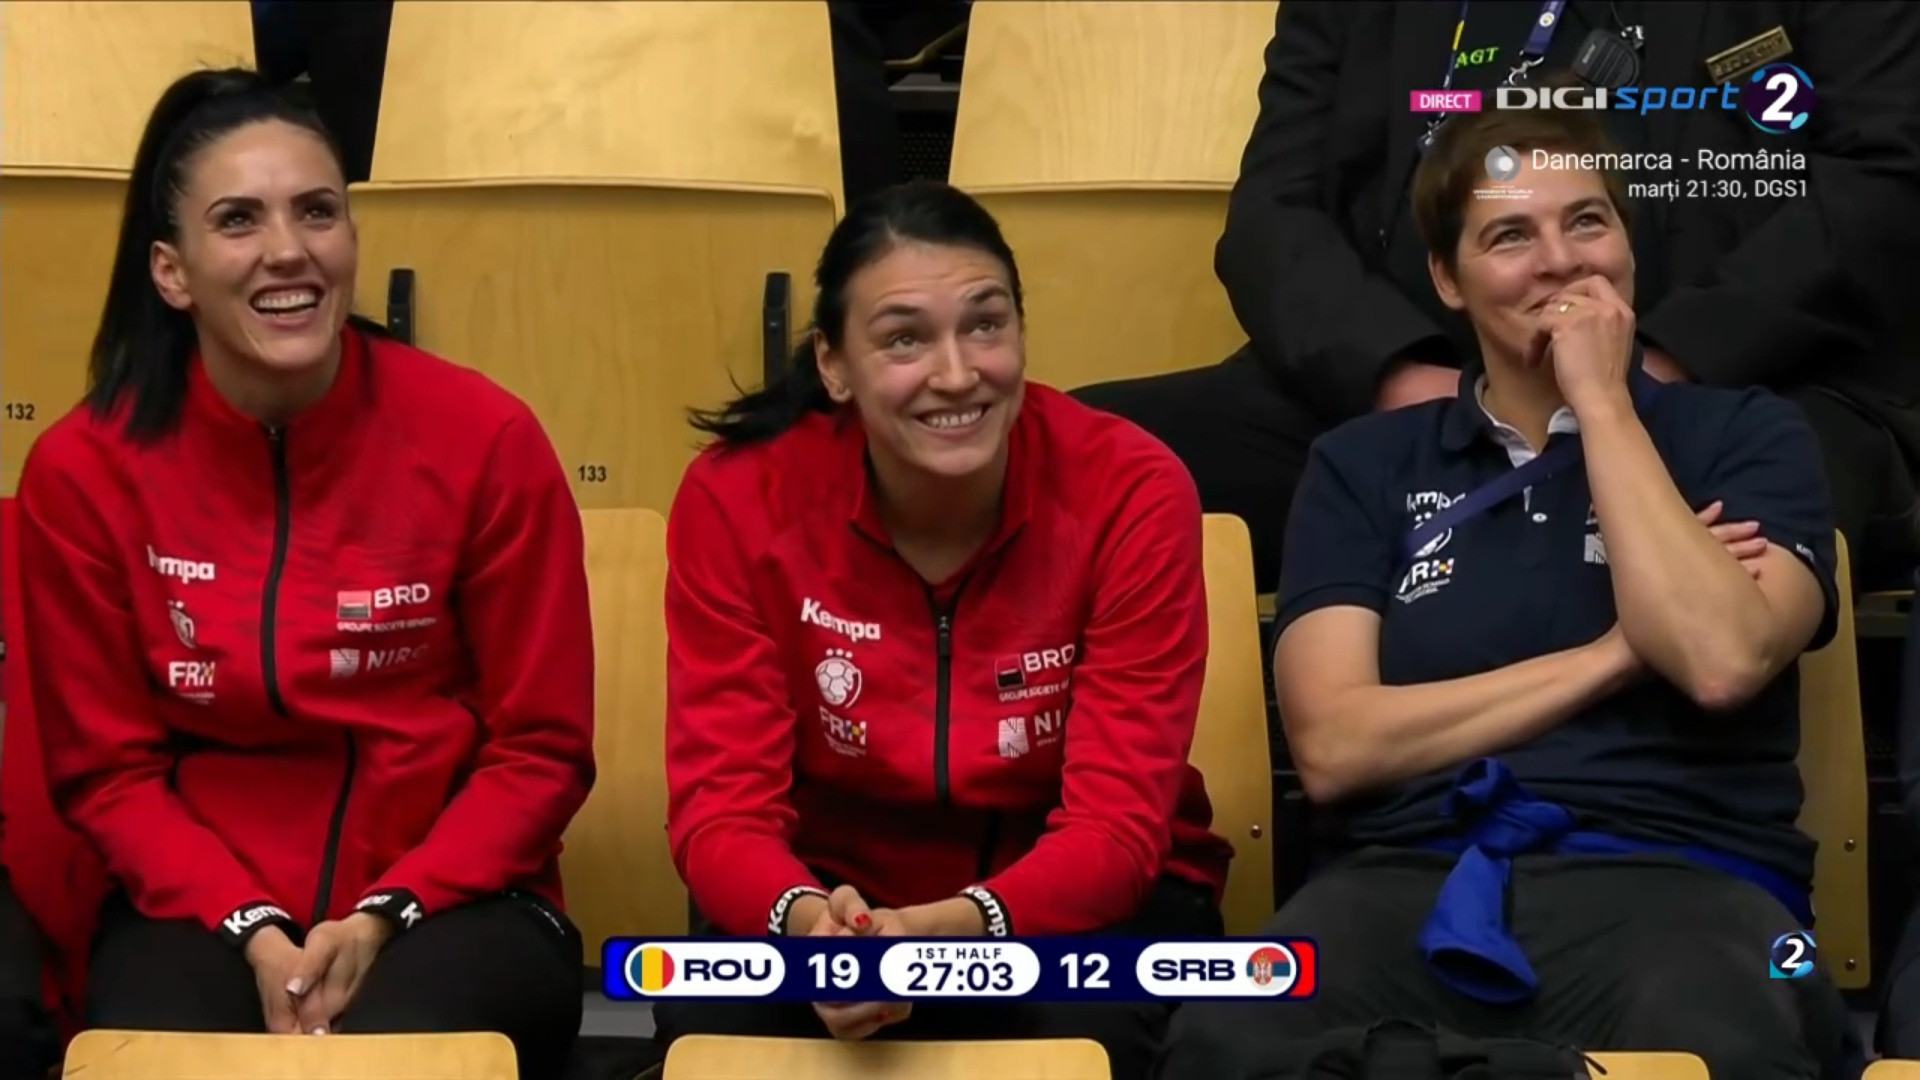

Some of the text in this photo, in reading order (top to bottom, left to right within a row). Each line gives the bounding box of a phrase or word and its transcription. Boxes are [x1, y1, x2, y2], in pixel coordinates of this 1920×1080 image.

[6, 403, 35, 421] 132
[578, 465, 607, 483] 133
[374, 583, 430, 609] BRD
[801, 597, 881, 642] Kempa
[1023, 644, 1075, 673] BRD
